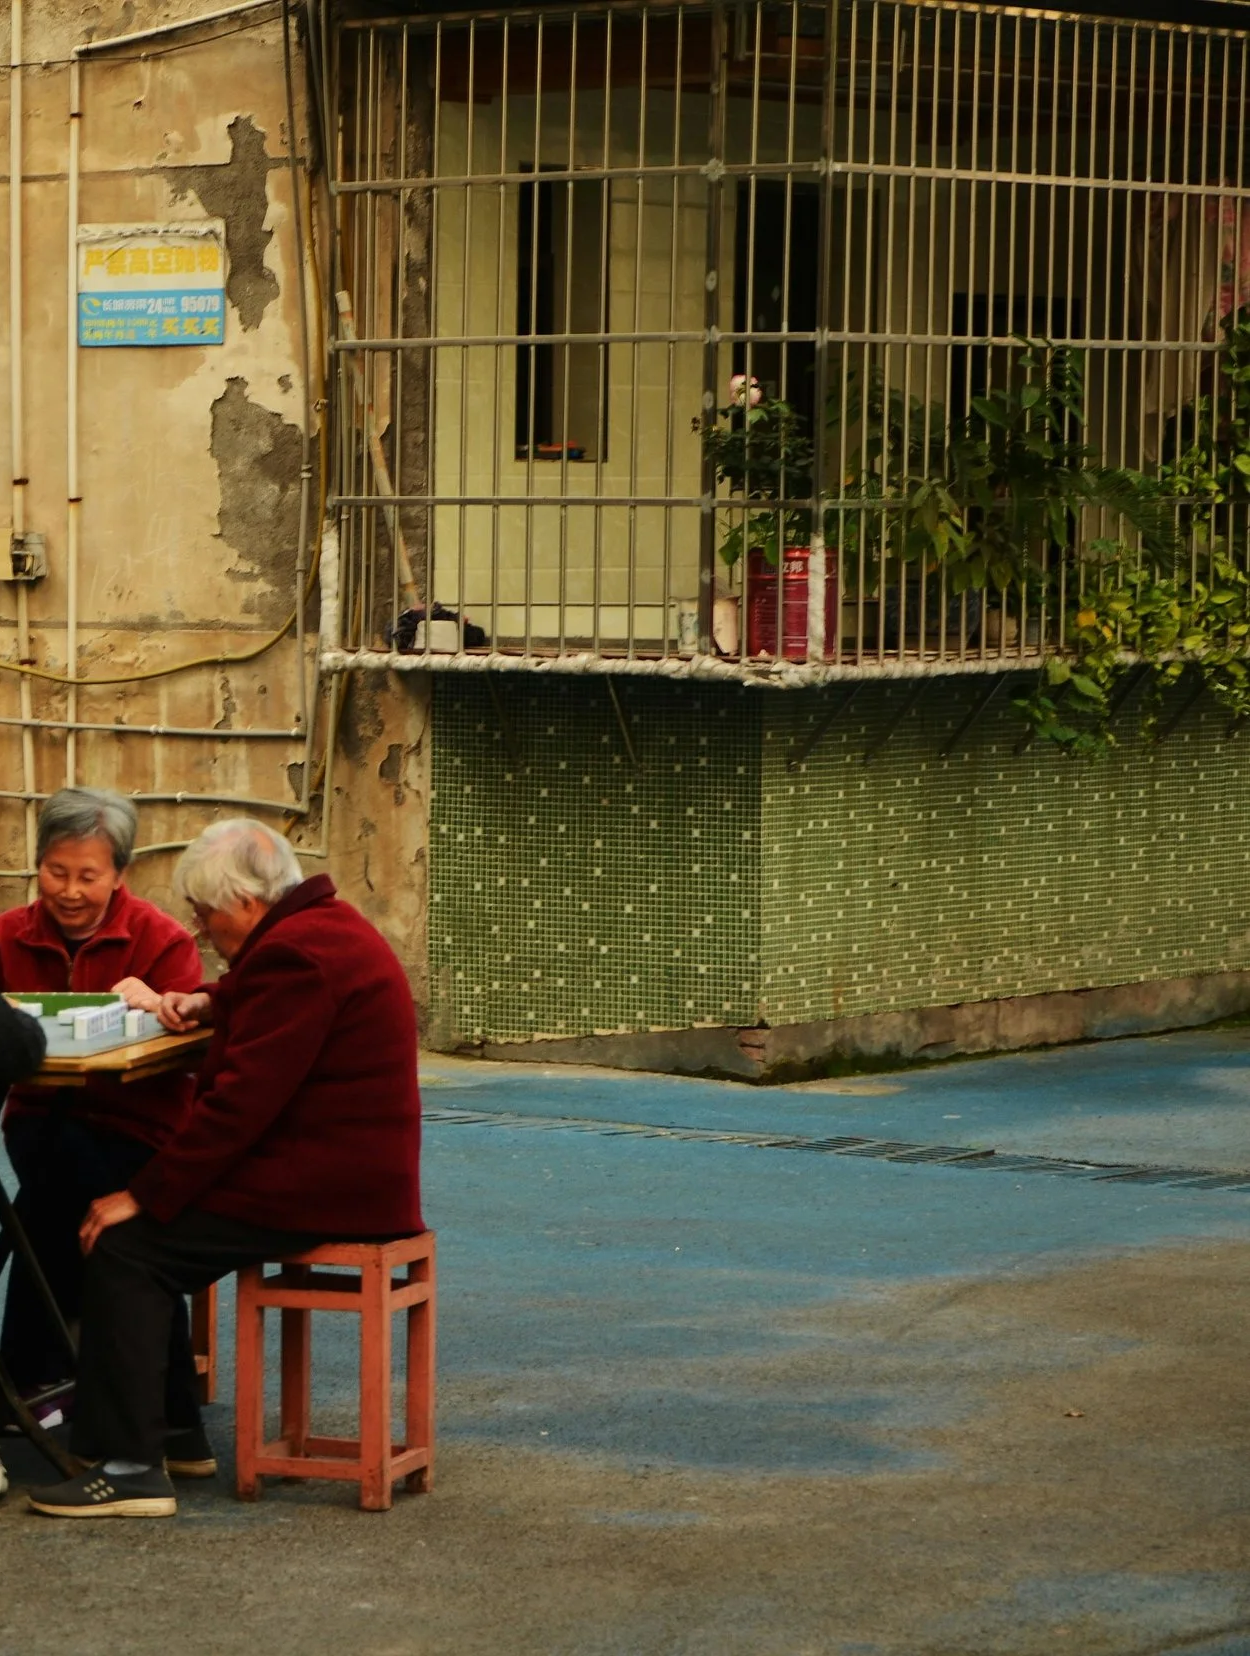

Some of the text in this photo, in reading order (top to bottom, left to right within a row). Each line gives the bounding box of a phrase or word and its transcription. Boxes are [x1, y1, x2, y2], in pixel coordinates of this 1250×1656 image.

[84, 246, 219, 275] 严禁高空抛物
